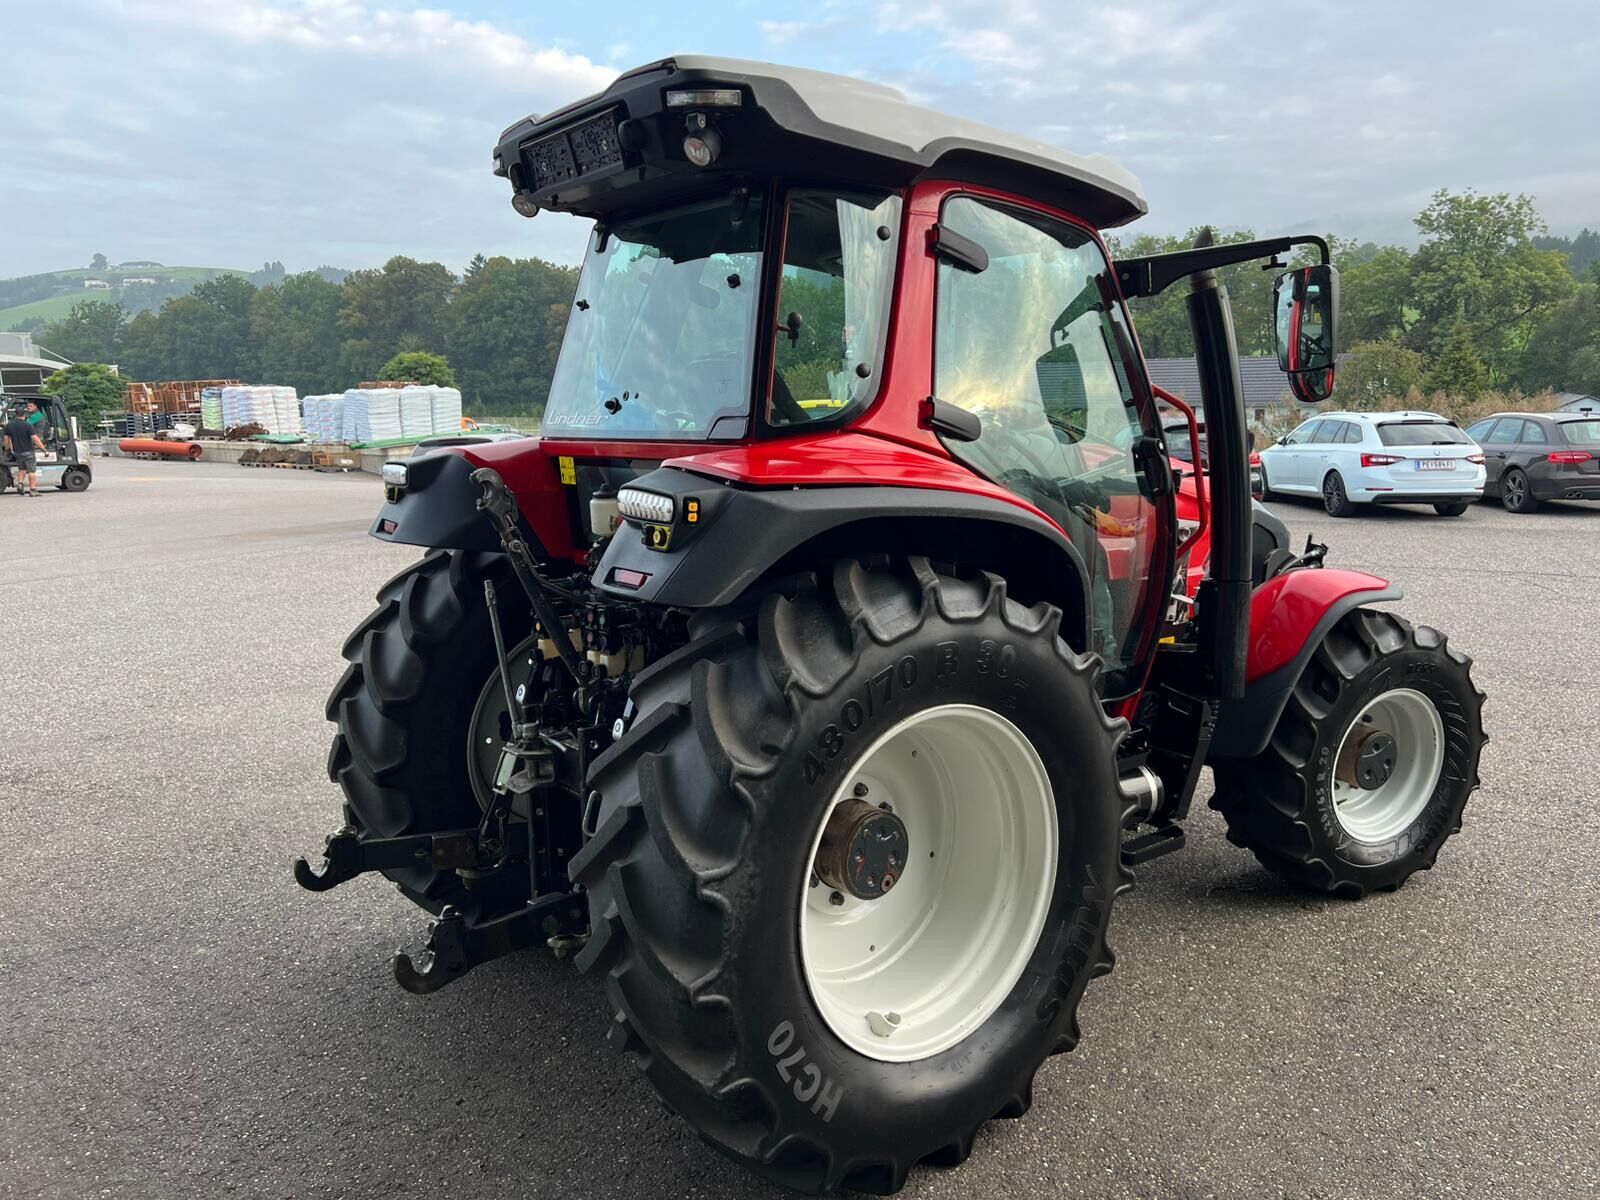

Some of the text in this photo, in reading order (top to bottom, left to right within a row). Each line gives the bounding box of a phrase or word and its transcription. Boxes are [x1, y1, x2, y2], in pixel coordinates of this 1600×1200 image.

[546, 409, 609, 425] Lindner
[935, 640, 961, 678] R
[1319, 746, 1330, 766] 20
[1316, 772, 1326, 782] R
[767, 1020, 844, 1123] HC70
